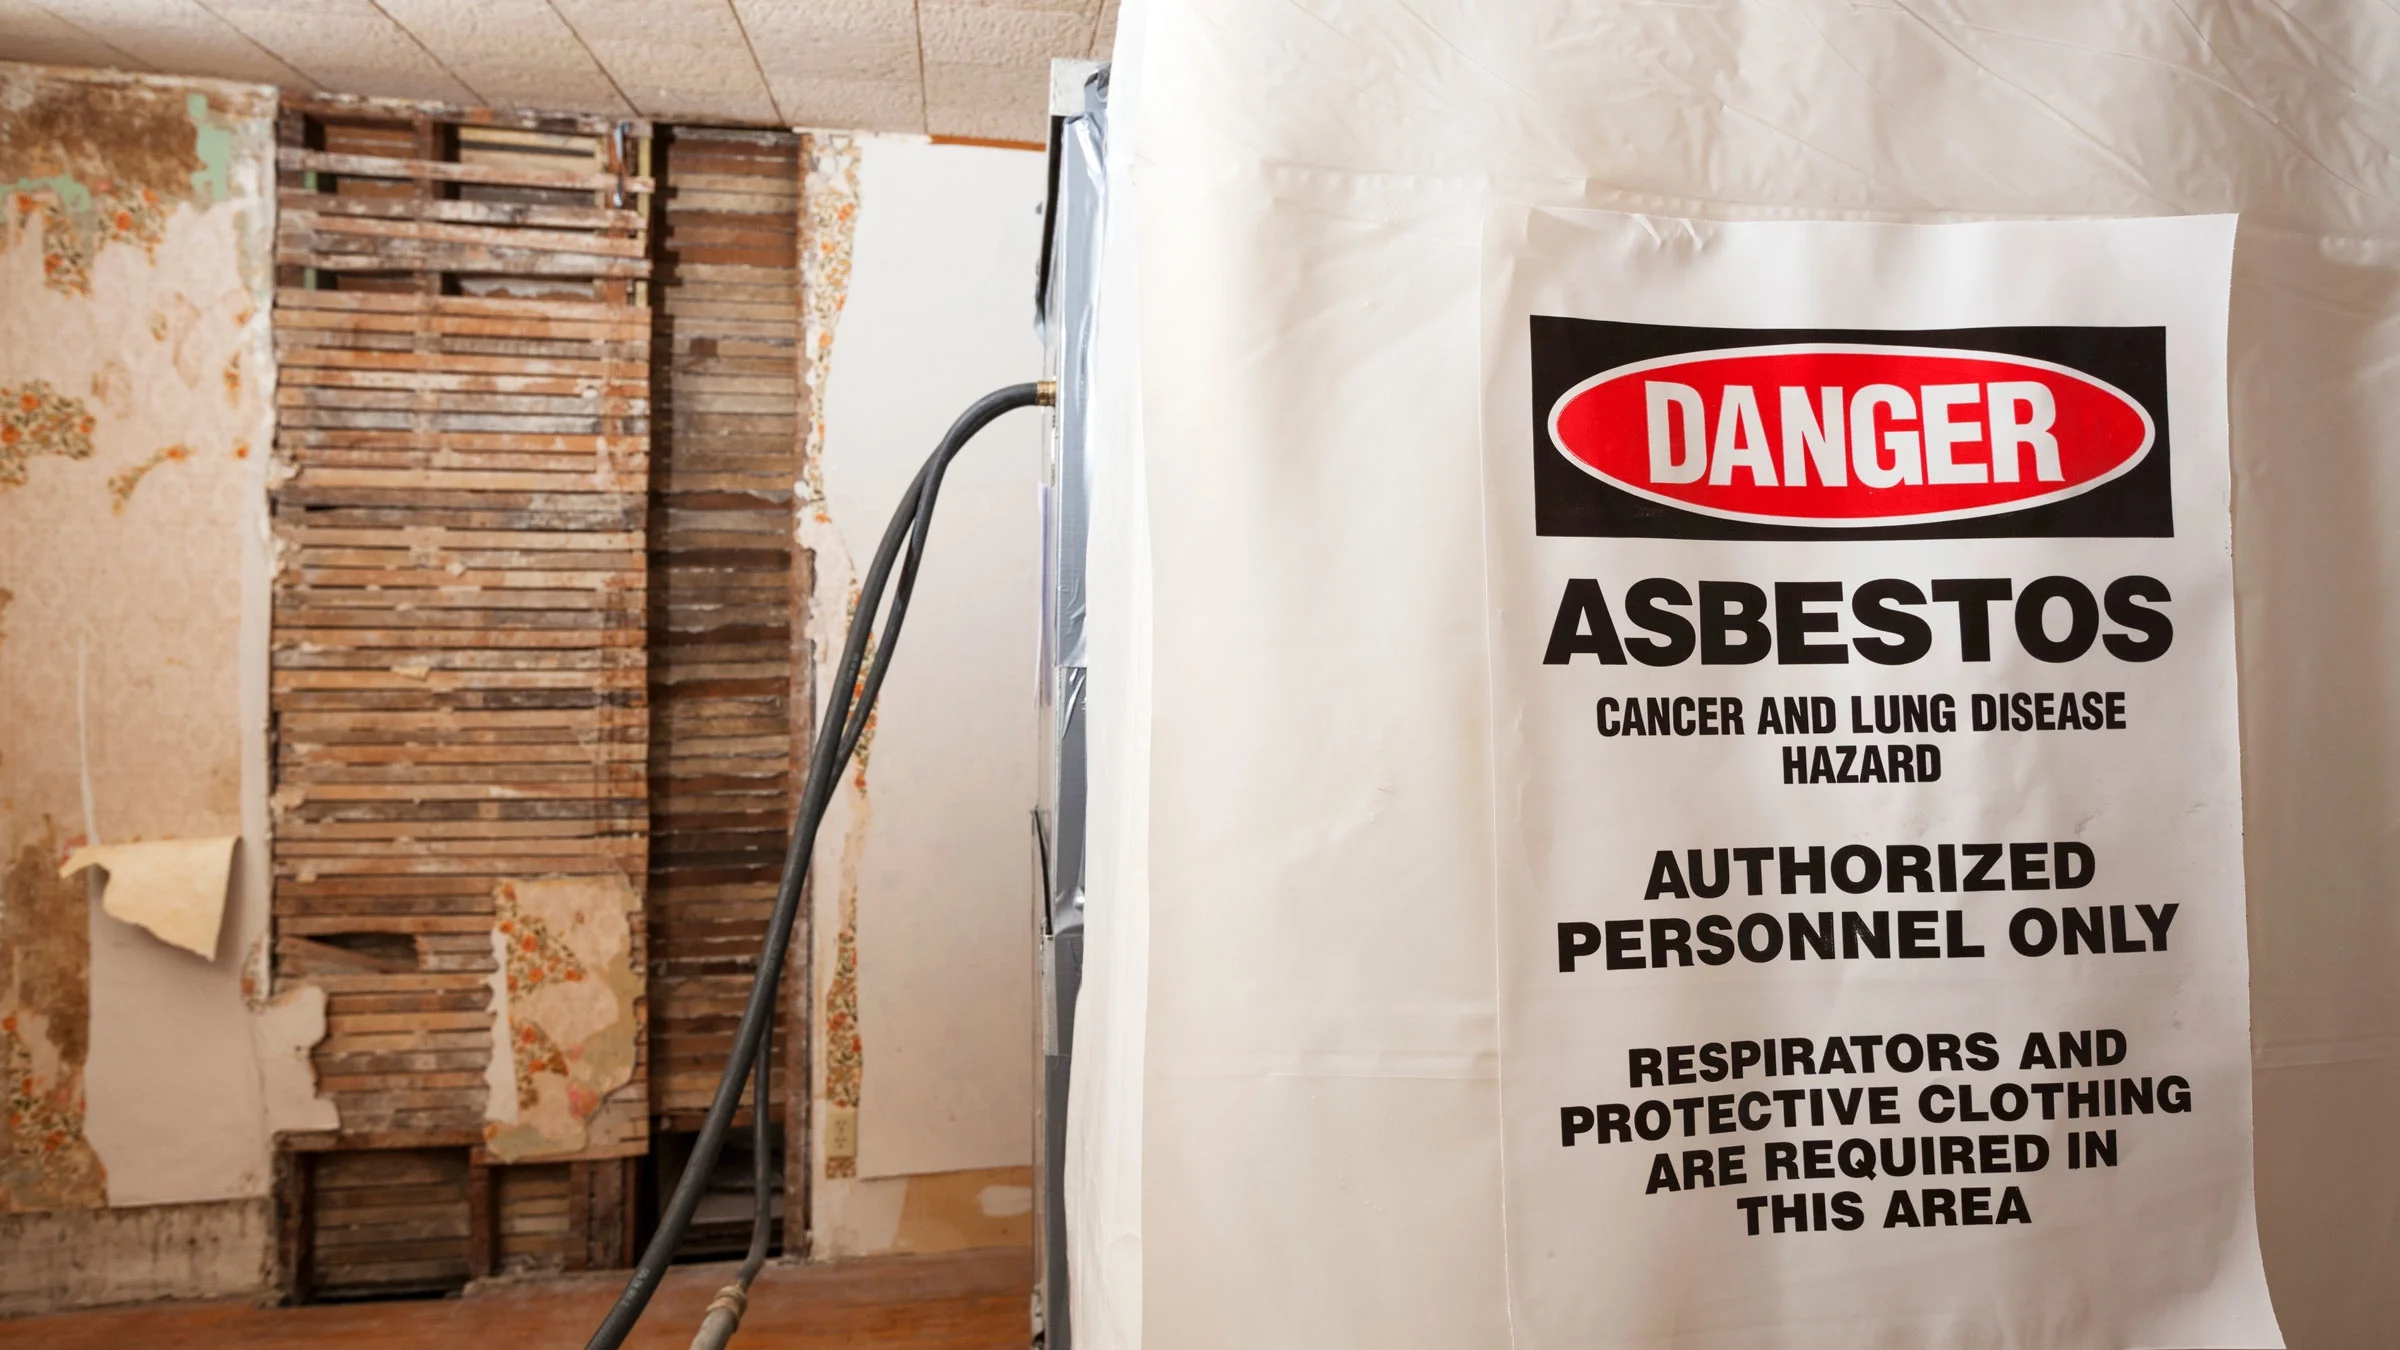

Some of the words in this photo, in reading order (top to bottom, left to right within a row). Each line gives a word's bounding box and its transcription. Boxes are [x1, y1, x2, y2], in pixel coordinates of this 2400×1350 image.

[1645, 381, 2066, 488] DANGER
[1543, 576, 2173, 667] ASBESTOS
[1597, 697, 1744, 737] CANCER
[1758, 697, 1836, 734] AND
[1852, 694, 1956, 733] LUNG
[1972, 692, 2126, 731] DISEASE
[1783, 744, 1941, 784] HAZARD
[1644, 842, 2095, 900] AUTHORIZED
[1558, 910, 1984, 972] PERSONNEL
[2009, 903, 2179, 957] ONLY
[1629, 1032, 1999, 1088] RESPIRATORS
[2019, 1029, 2127, 1069] AND
[1561, 1087, 1900, 1147] PROTECTIVE
[1919, 1075, 2191, 1123] CLOTHING
[1646, 1145, 1747, 1194] ARE
[1765, 1135, 2049, 1181] REQUIRED
[2068, 1129, 2117, 1170] IN
[1737, 1191, 1864, 1236] THIS
[1883, 1186, 2032, 1228] AREA
